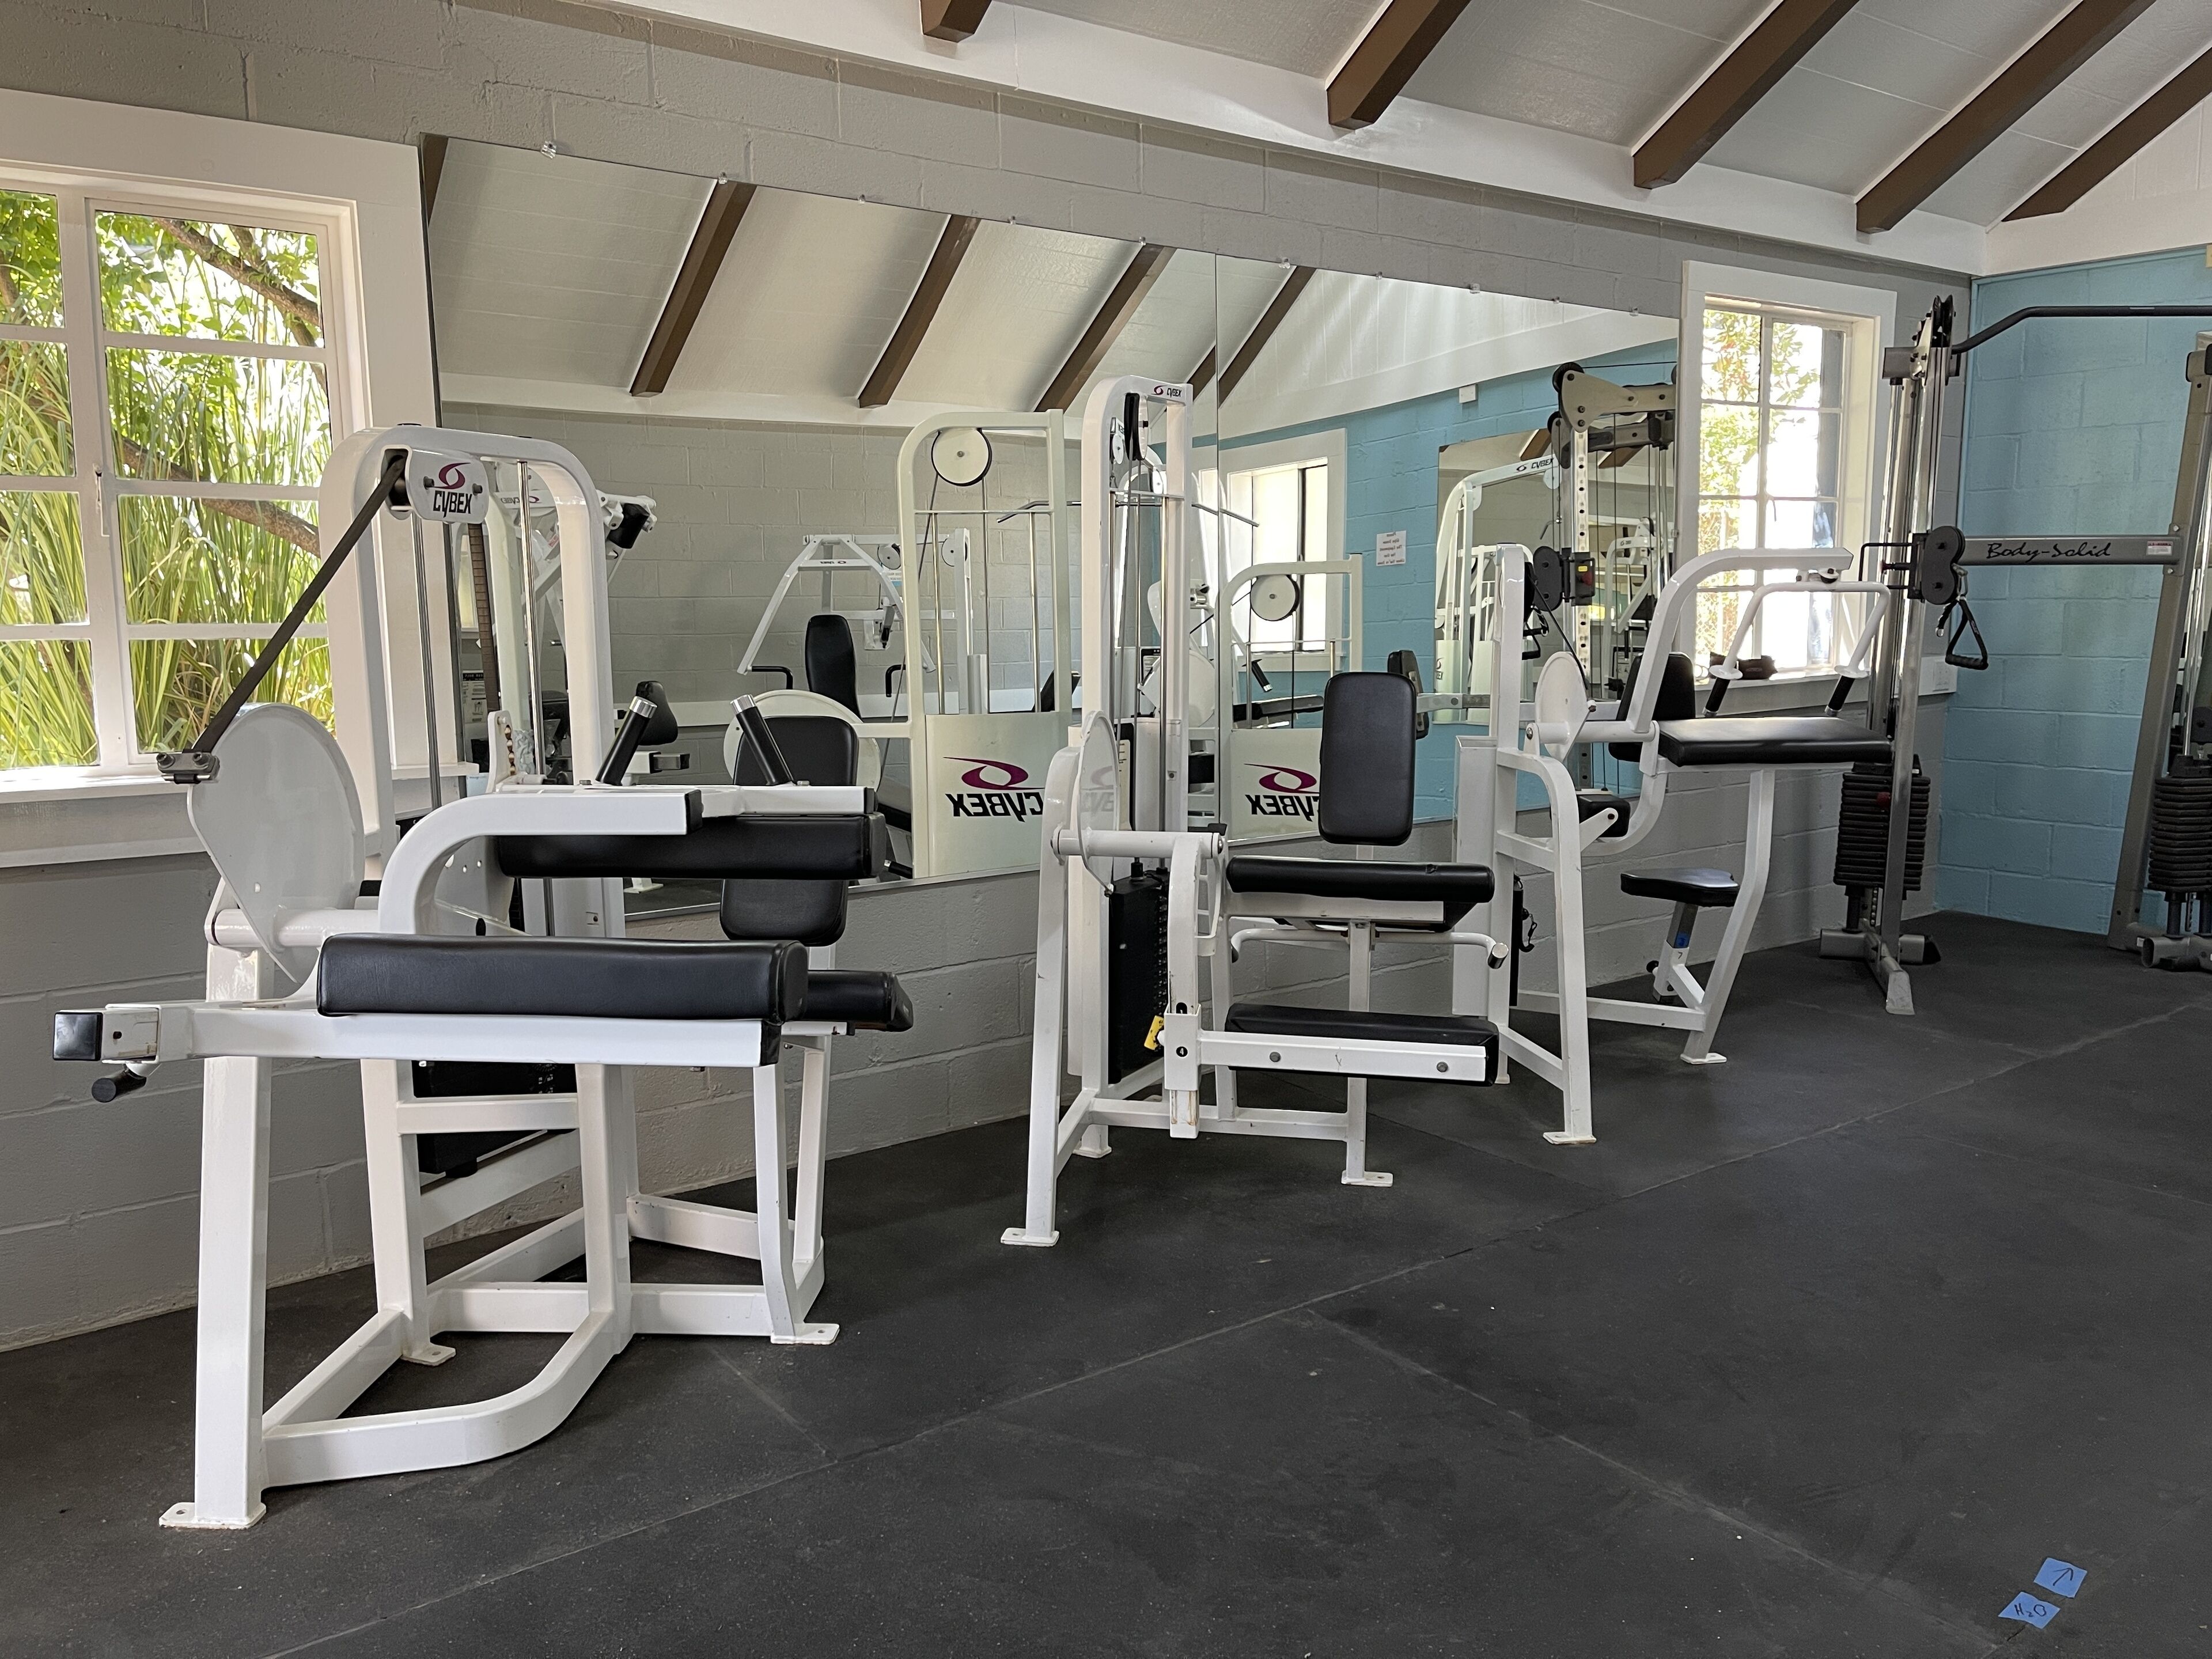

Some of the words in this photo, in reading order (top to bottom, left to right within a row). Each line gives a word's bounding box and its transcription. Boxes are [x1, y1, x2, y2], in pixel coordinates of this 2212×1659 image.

[1166, 388, 1181, 397] CYBEX
[1531, 458, 1554, 469] CYBEX
[433, 490, 472, 518] CYBEX
[1986, 541, 2112, 563] Body-Solid
